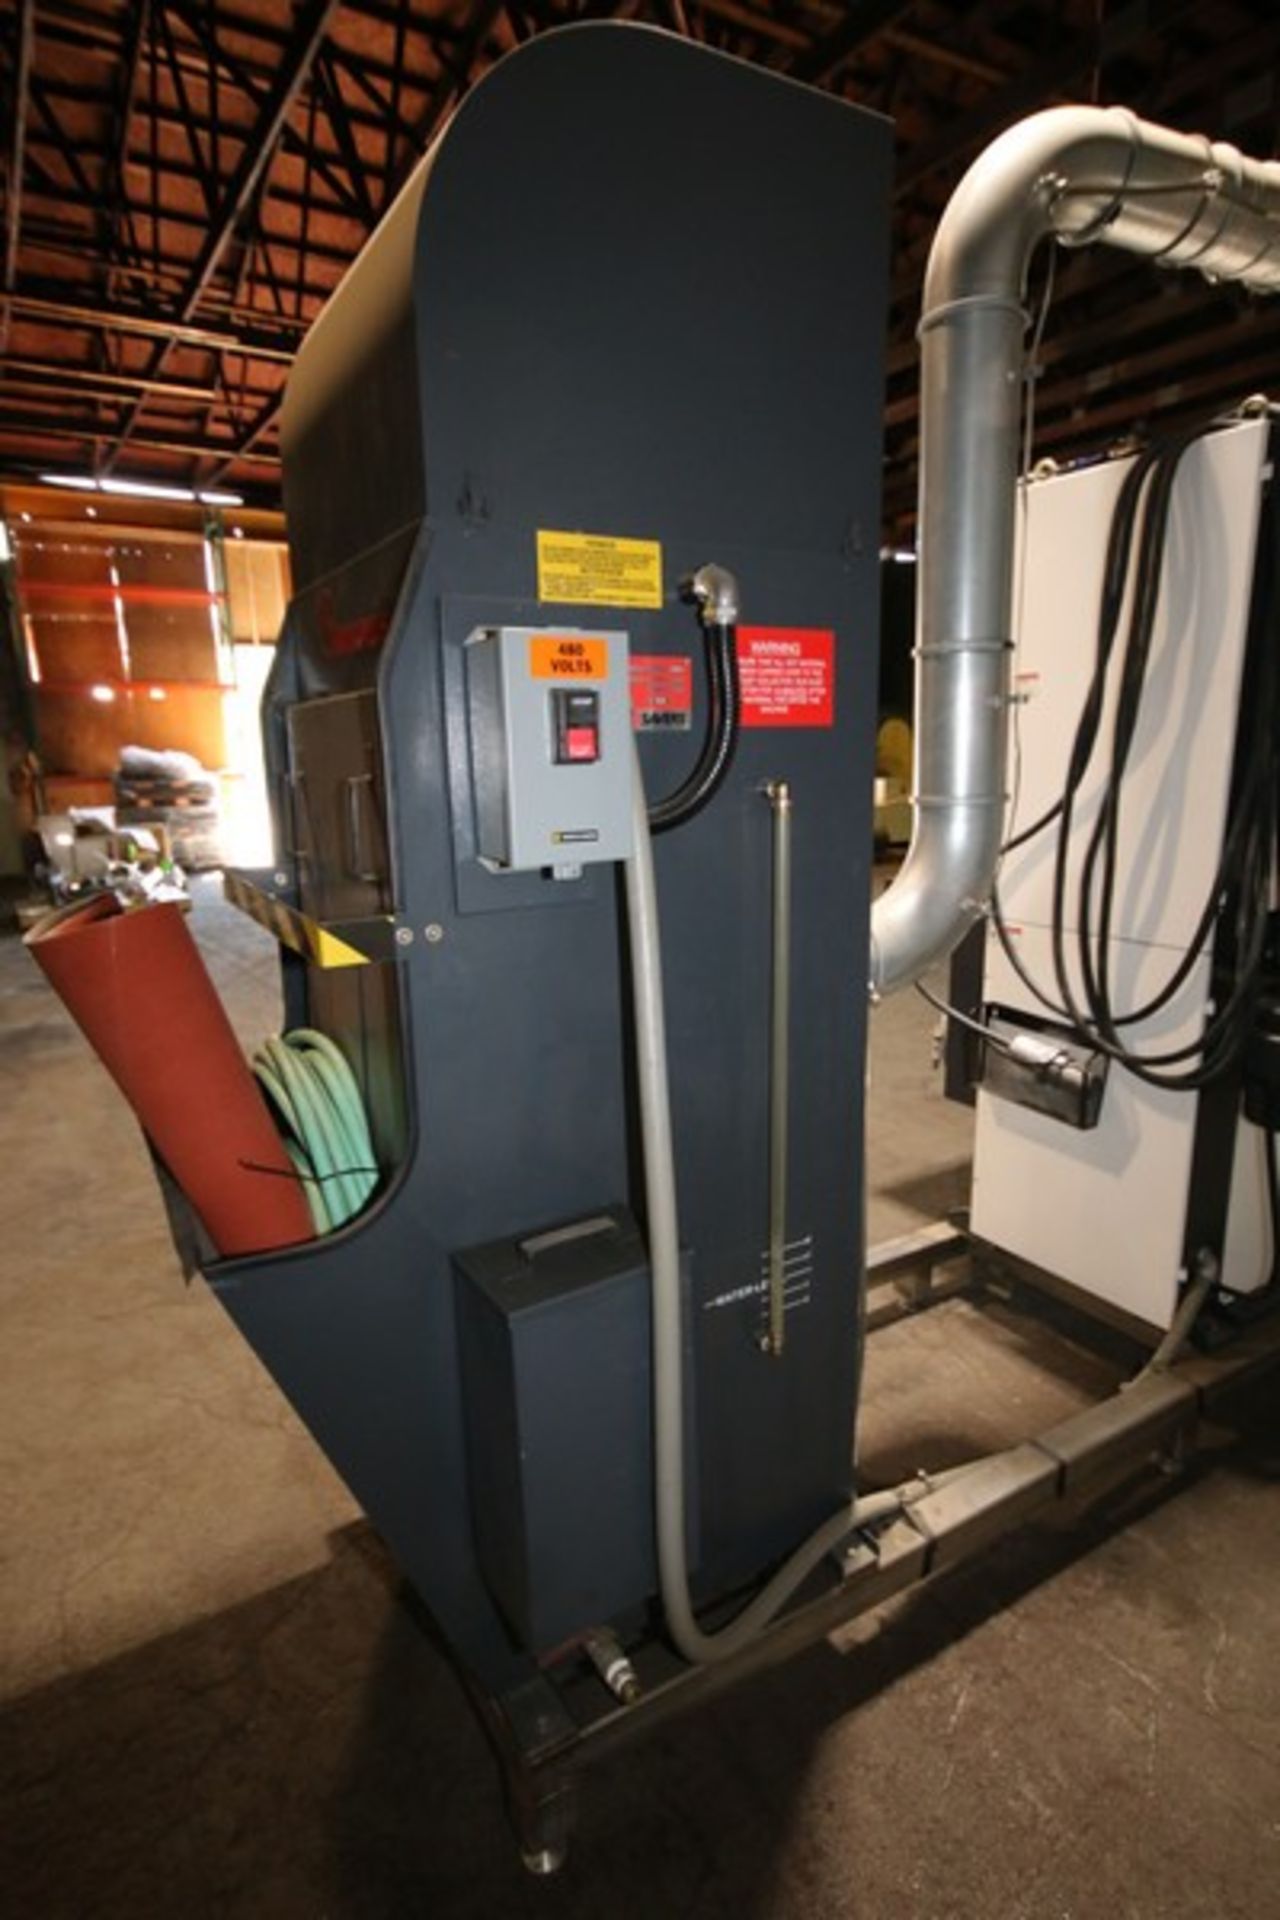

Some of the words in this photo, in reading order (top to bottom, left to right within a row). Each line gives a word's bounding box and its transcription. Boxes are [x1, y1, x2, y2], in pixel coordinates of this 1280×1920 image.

[558, 643, 586, 657] 480
[751, 640, 801, 657] WARNING
[550, 658, 593, 674] VOLTS
